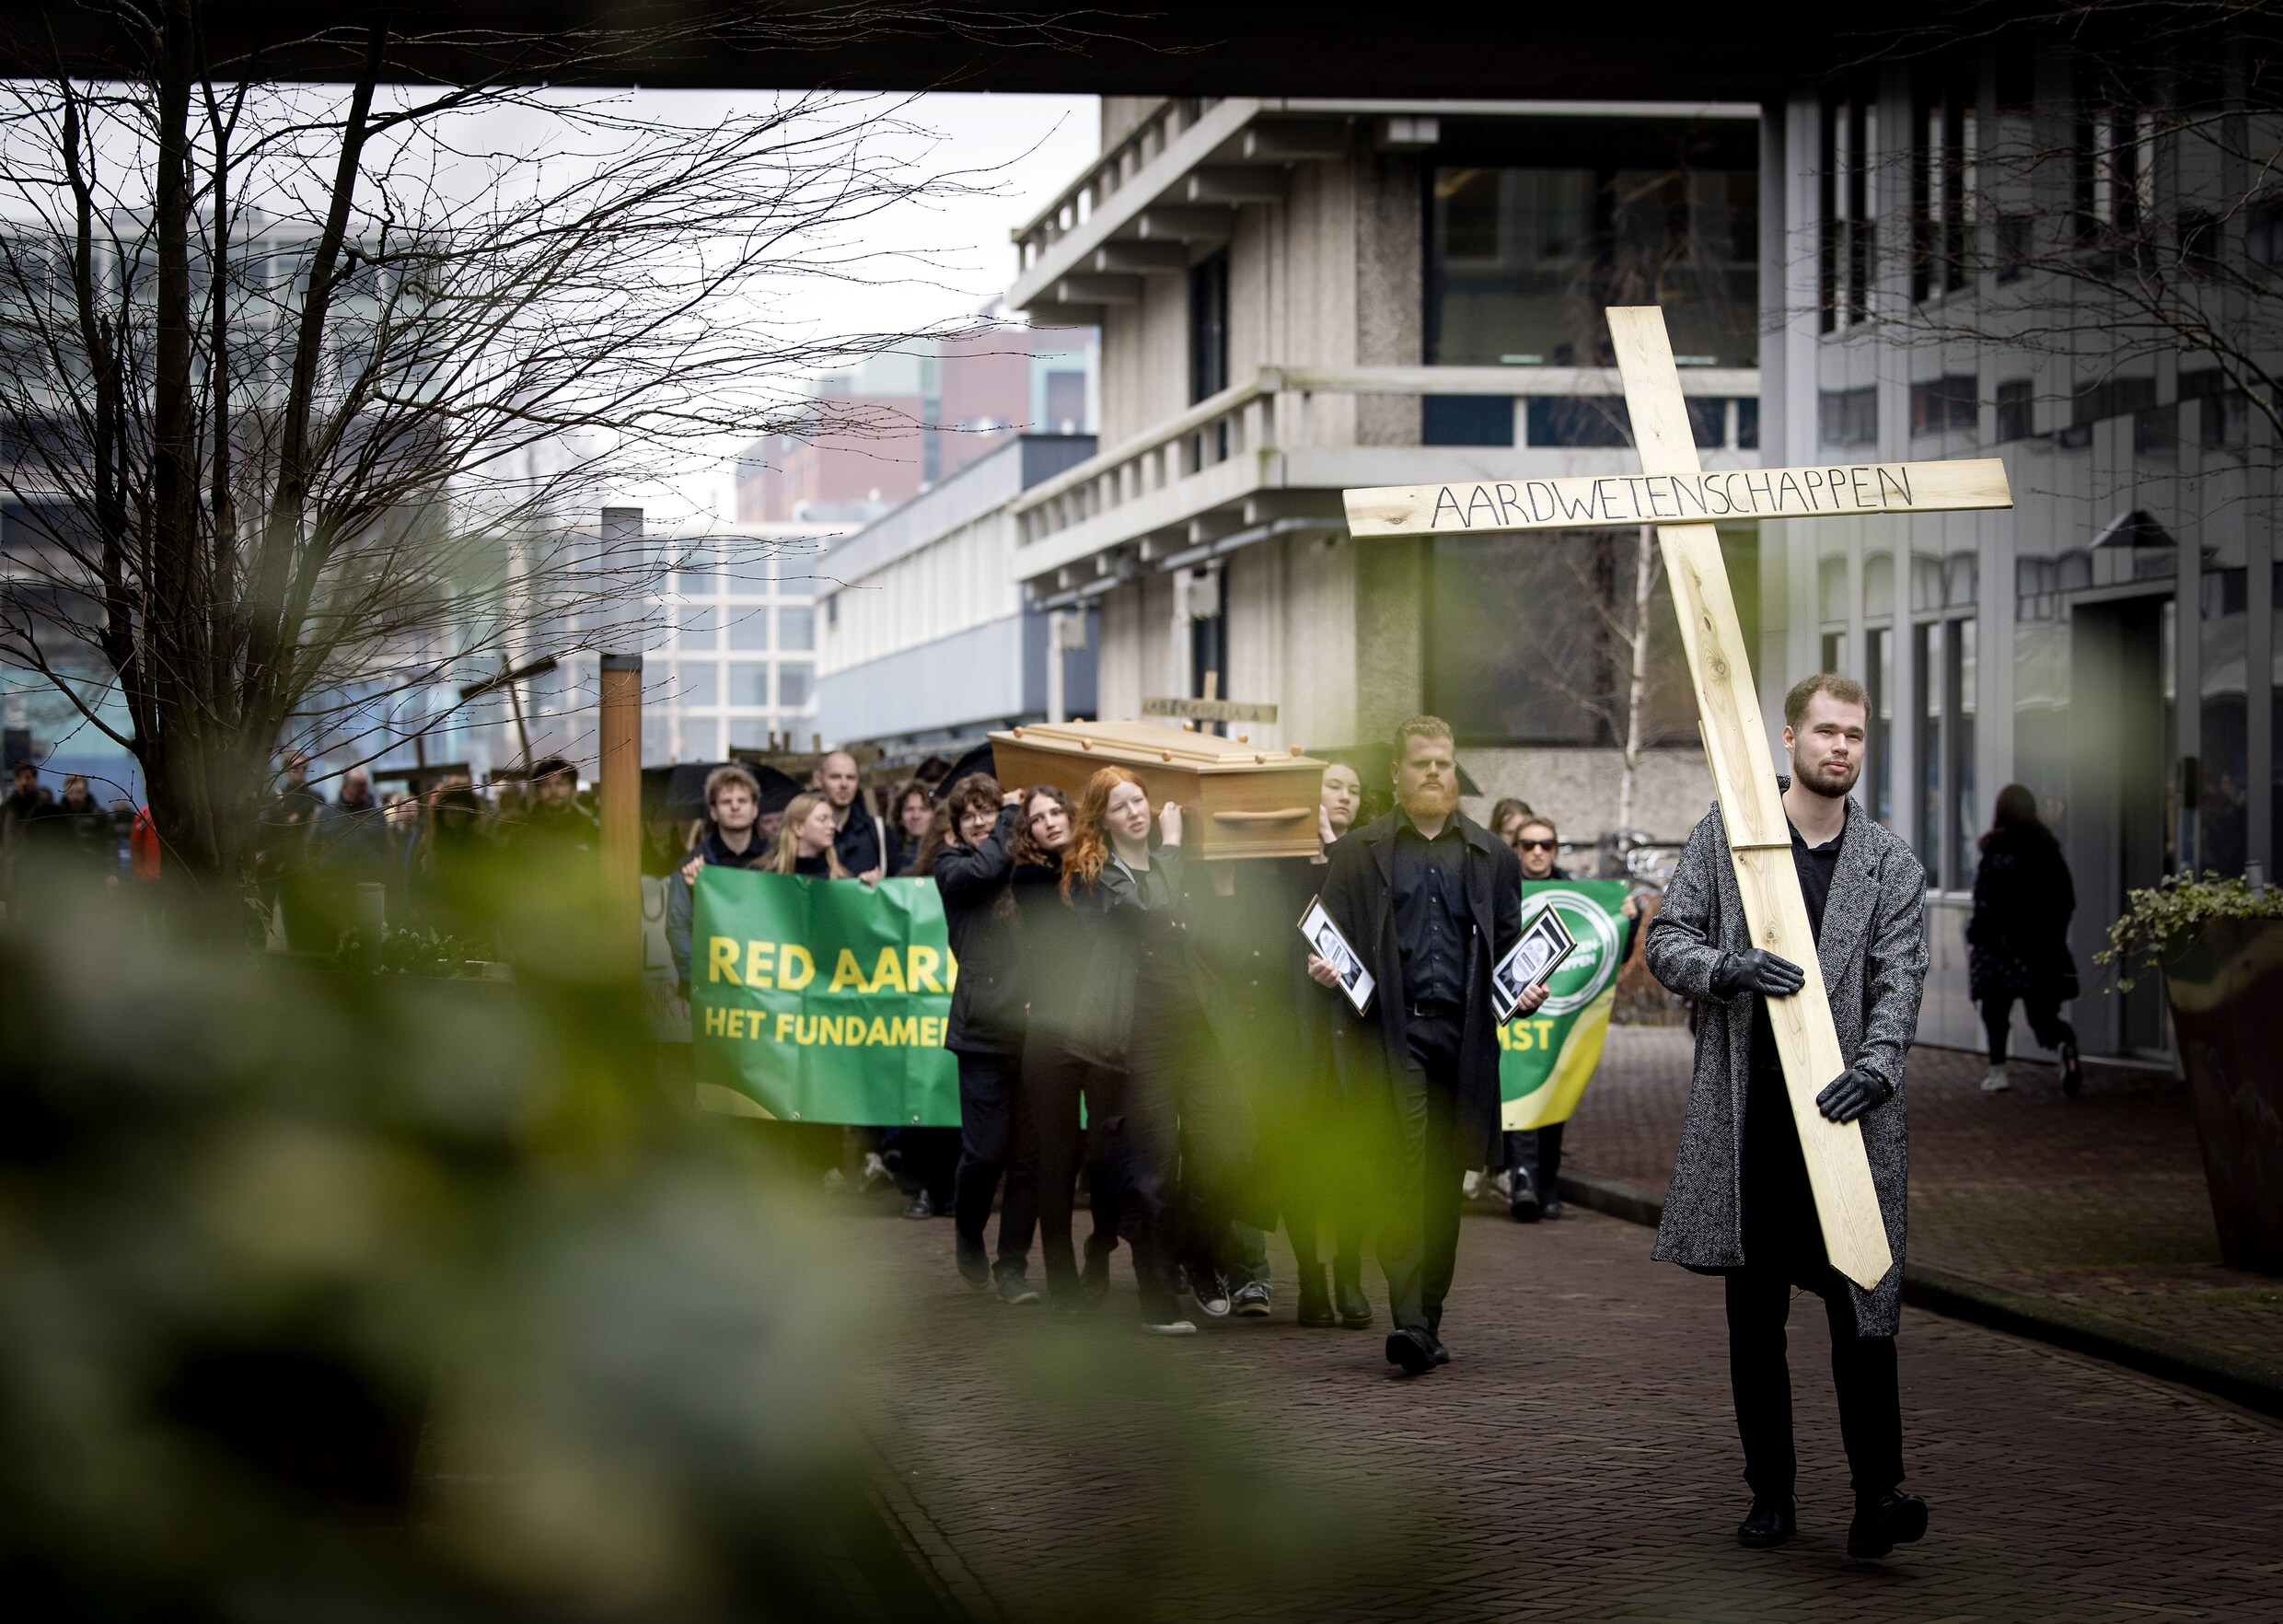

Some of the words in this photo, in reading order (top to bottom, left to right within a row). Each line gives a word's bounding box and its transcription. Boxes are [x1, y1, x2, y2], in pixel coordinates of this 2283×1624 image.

[1431, 466, 1914, 528] AARDWETENSCHAPPEN
[709, 935, 816, 992] RED
[705, 1006, 766, 1040] HET
[775, 1015, 949, 1047] FUNDAME
